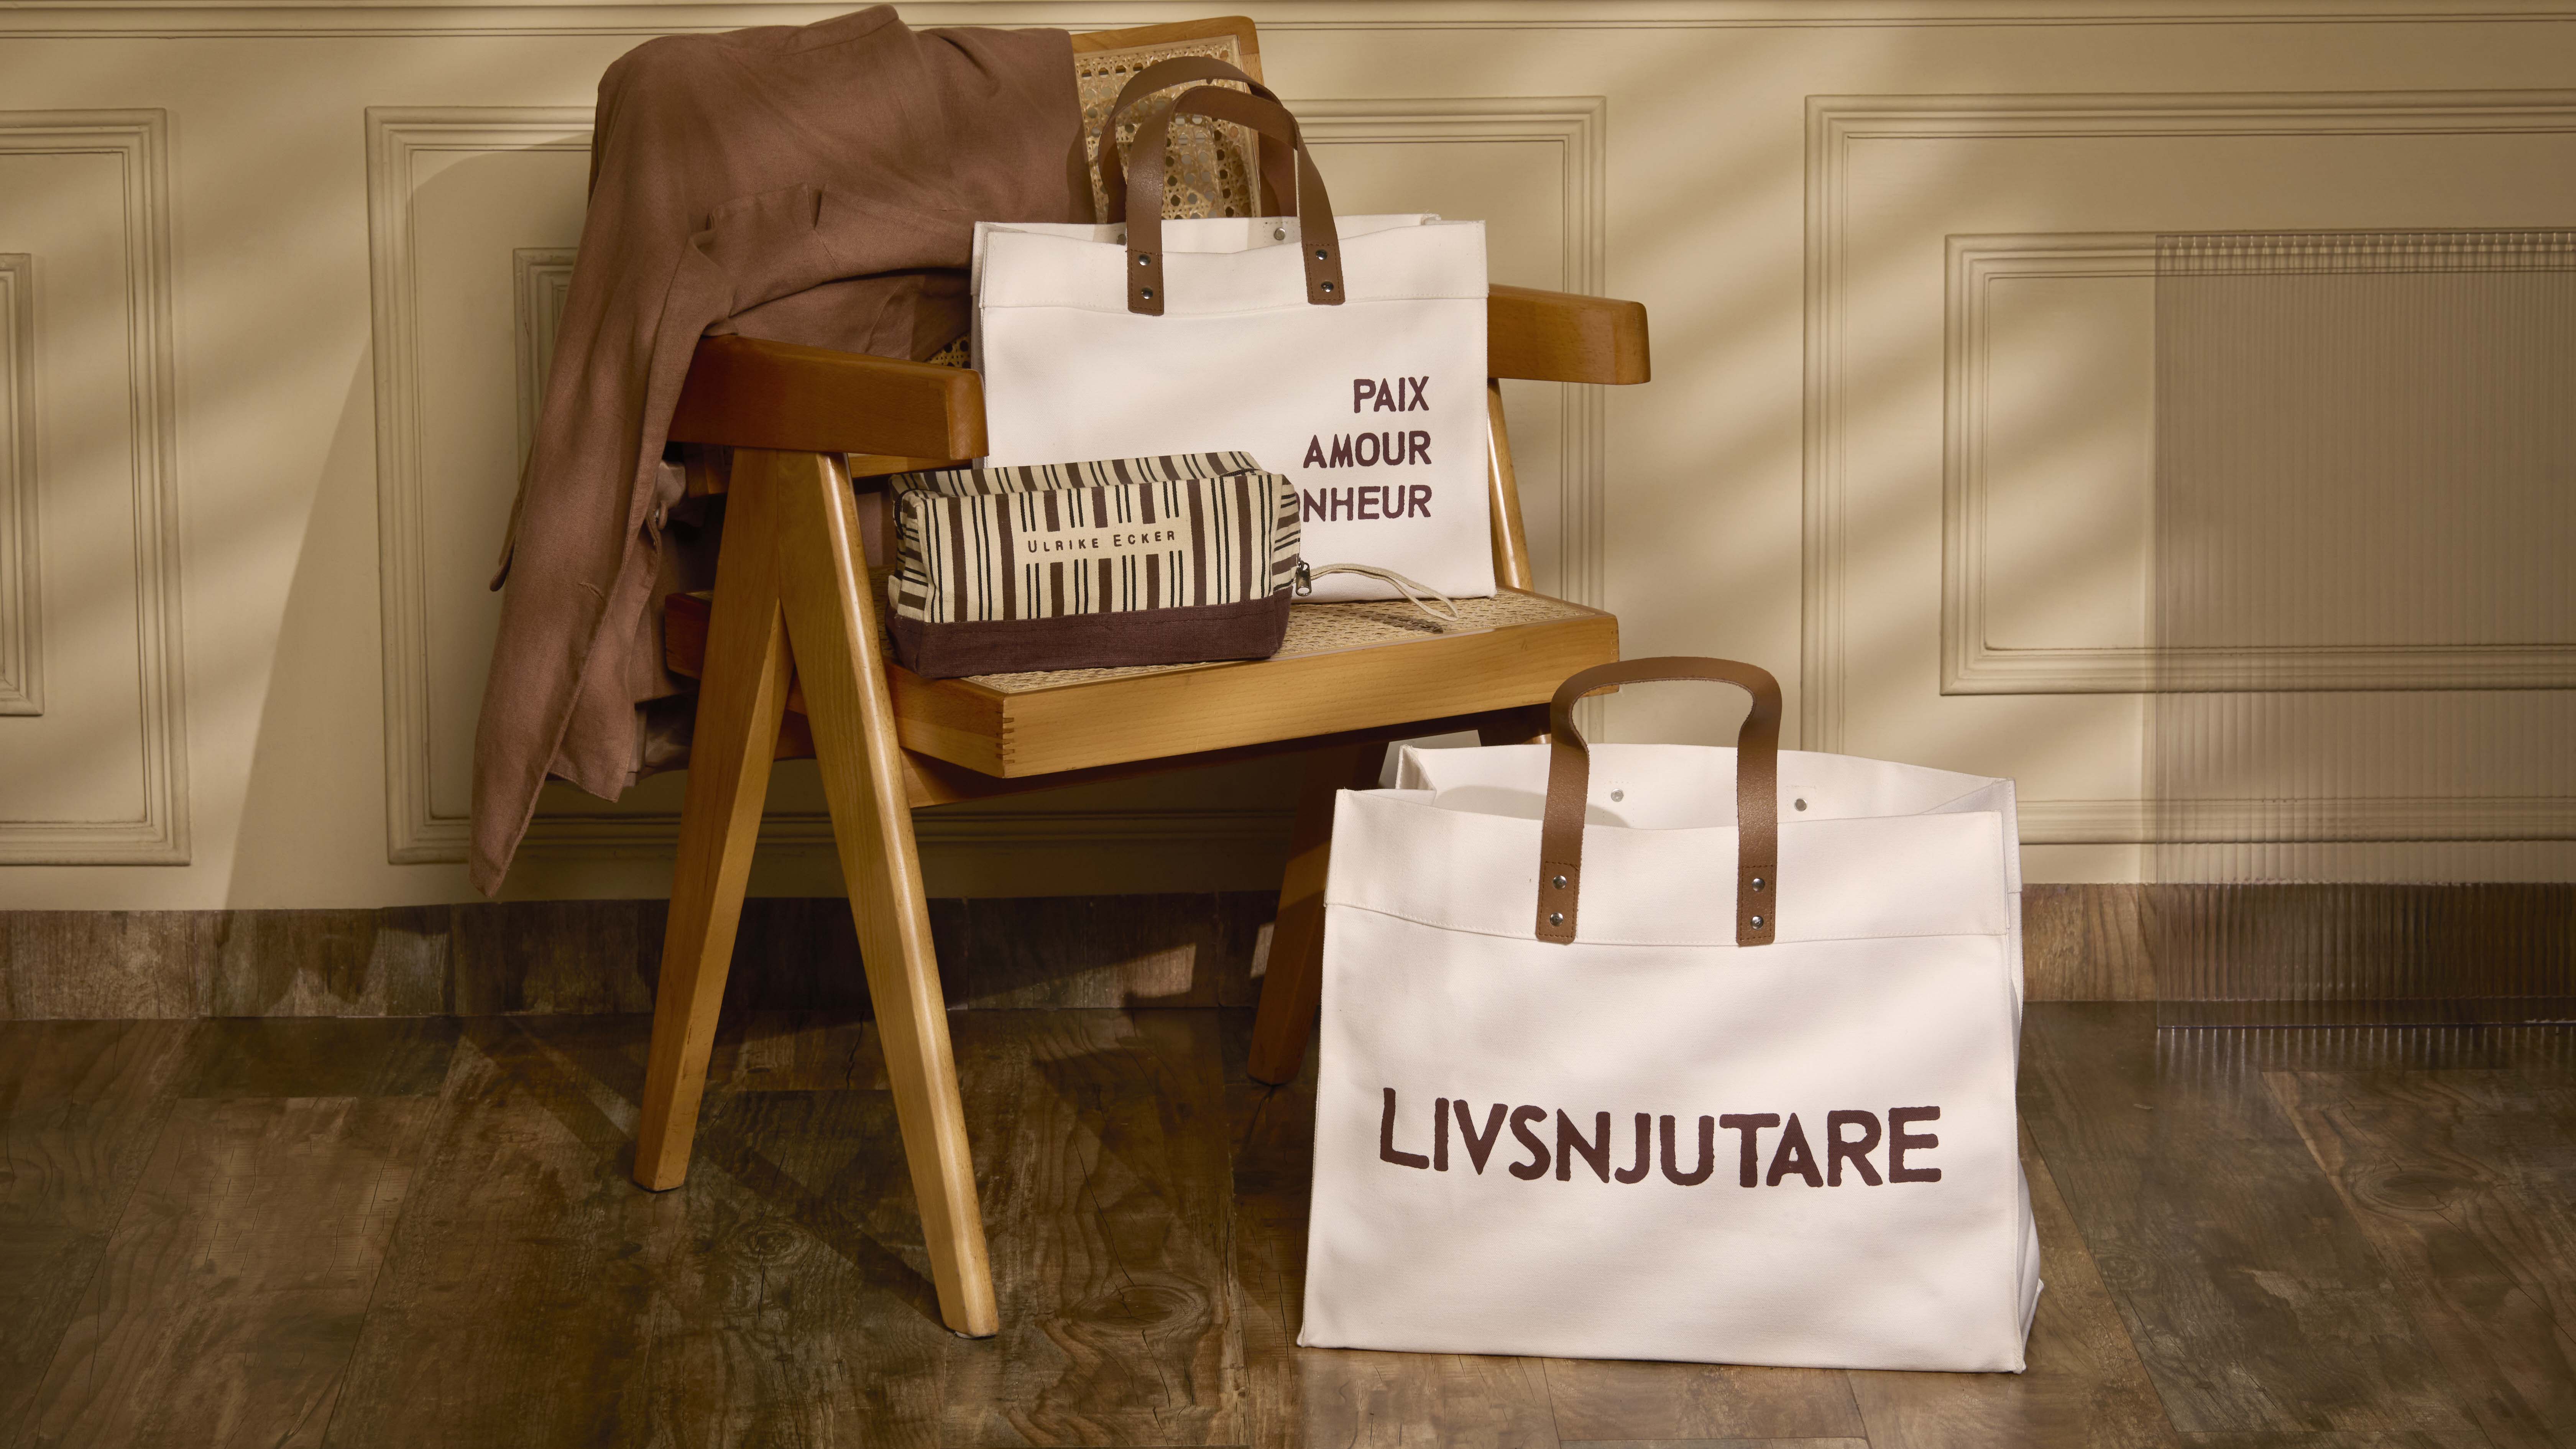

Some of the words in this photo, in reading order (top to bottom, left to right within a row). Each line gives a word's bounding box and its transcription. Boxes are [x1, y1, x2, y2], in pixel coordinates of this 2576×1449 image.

[1354, 376, 1429, 413] PAIX
[1303, 430, 1431, 468] AMOUR
[1295, 485, 1432, 522] NHEUR
[1028, 538, 1099, 553] ULRIKE
[1114, 531, 1174, 547] ECKER
[1380, 1088, 1941, 1188] LIVSNJUTARE
